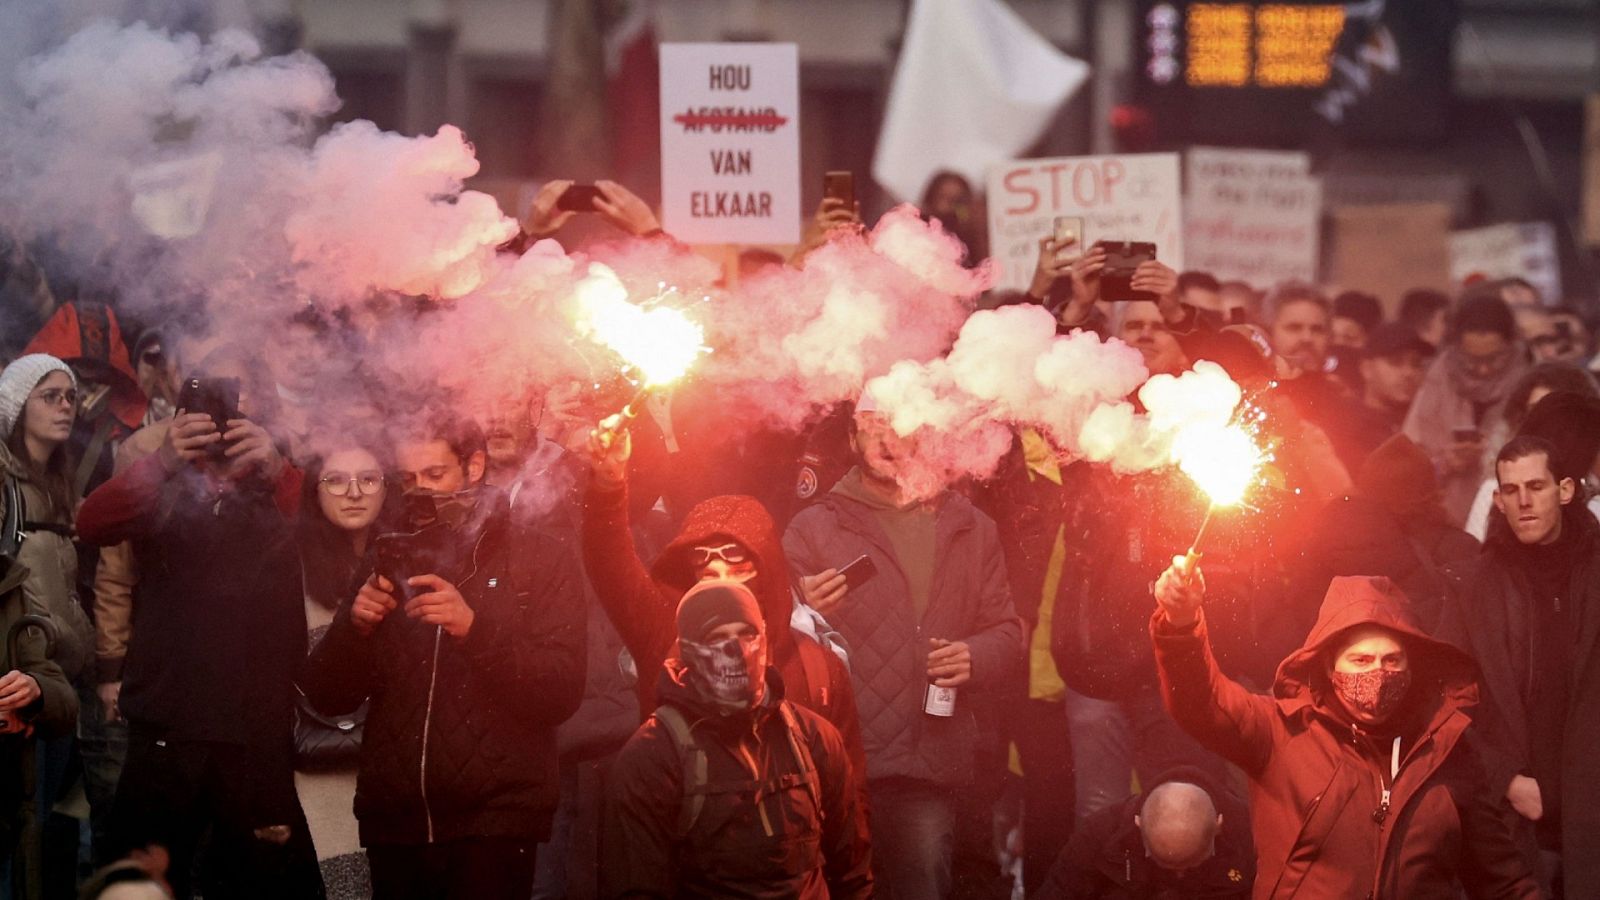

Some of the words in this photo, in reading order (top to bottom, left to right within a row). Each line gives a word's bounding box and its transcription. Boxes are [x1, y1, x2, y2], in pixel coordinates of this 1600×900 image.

[709, 64, 751, 91] HOU
[710, 151, 751, 175] VAN
[1003, 160, 1126, 216] STOP
[691, 192, 772, 217] ELKAAR
